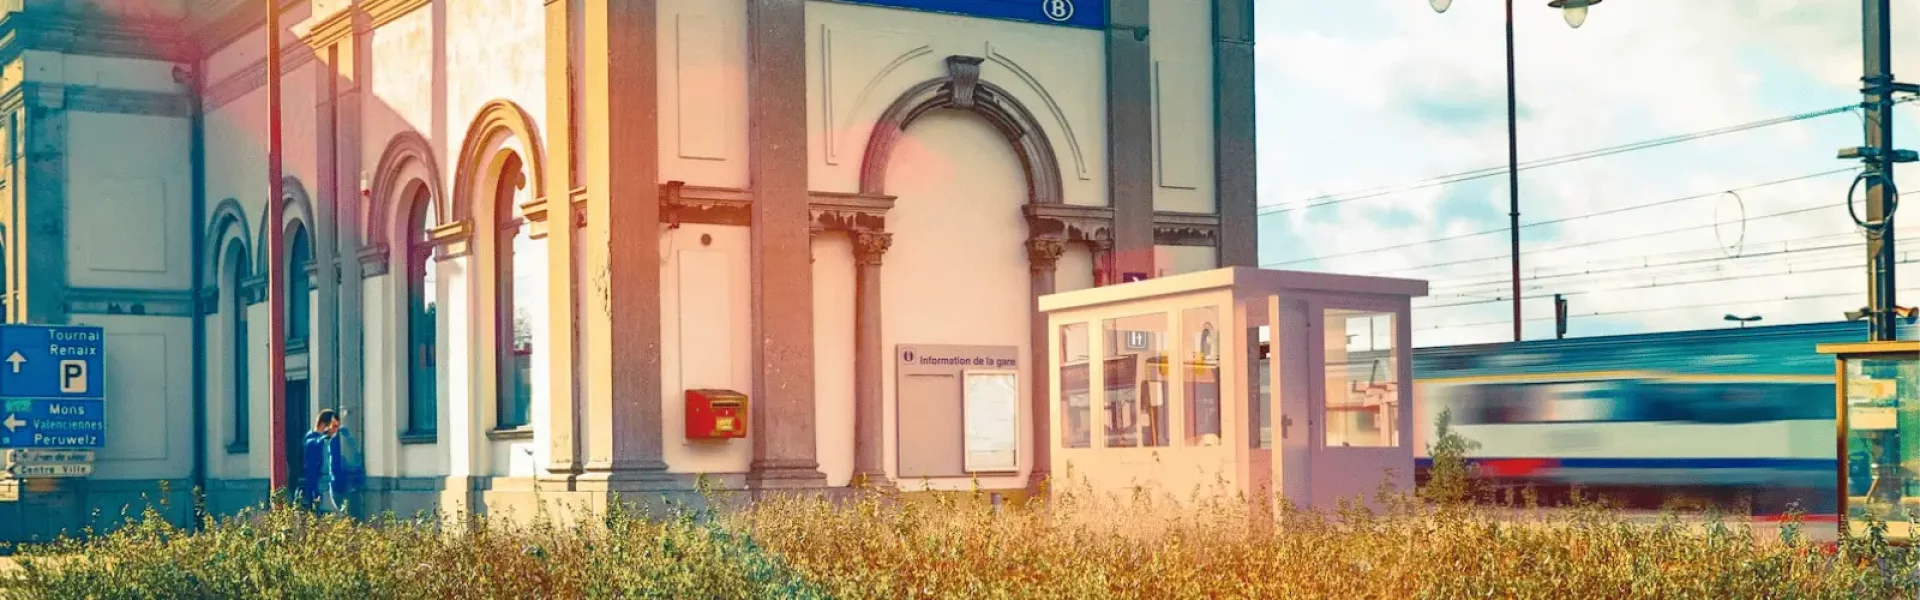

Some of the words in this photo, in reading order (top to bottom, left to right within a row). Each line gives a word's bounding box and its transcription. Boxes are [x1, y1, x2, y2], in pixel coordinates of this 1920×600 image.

[48, 328, 100, 341] Tournai
[49, 343, 97, 356] Renaix
[973, 356, 985, 366] de
[986, 357, 994, 366] la
[996, 358, 1016, 369] gare
[49, 403, 85, 416] Mons
[33, 418, 103, 431] Valenciennes
[34, 433, 97, 446] Peruwelz
